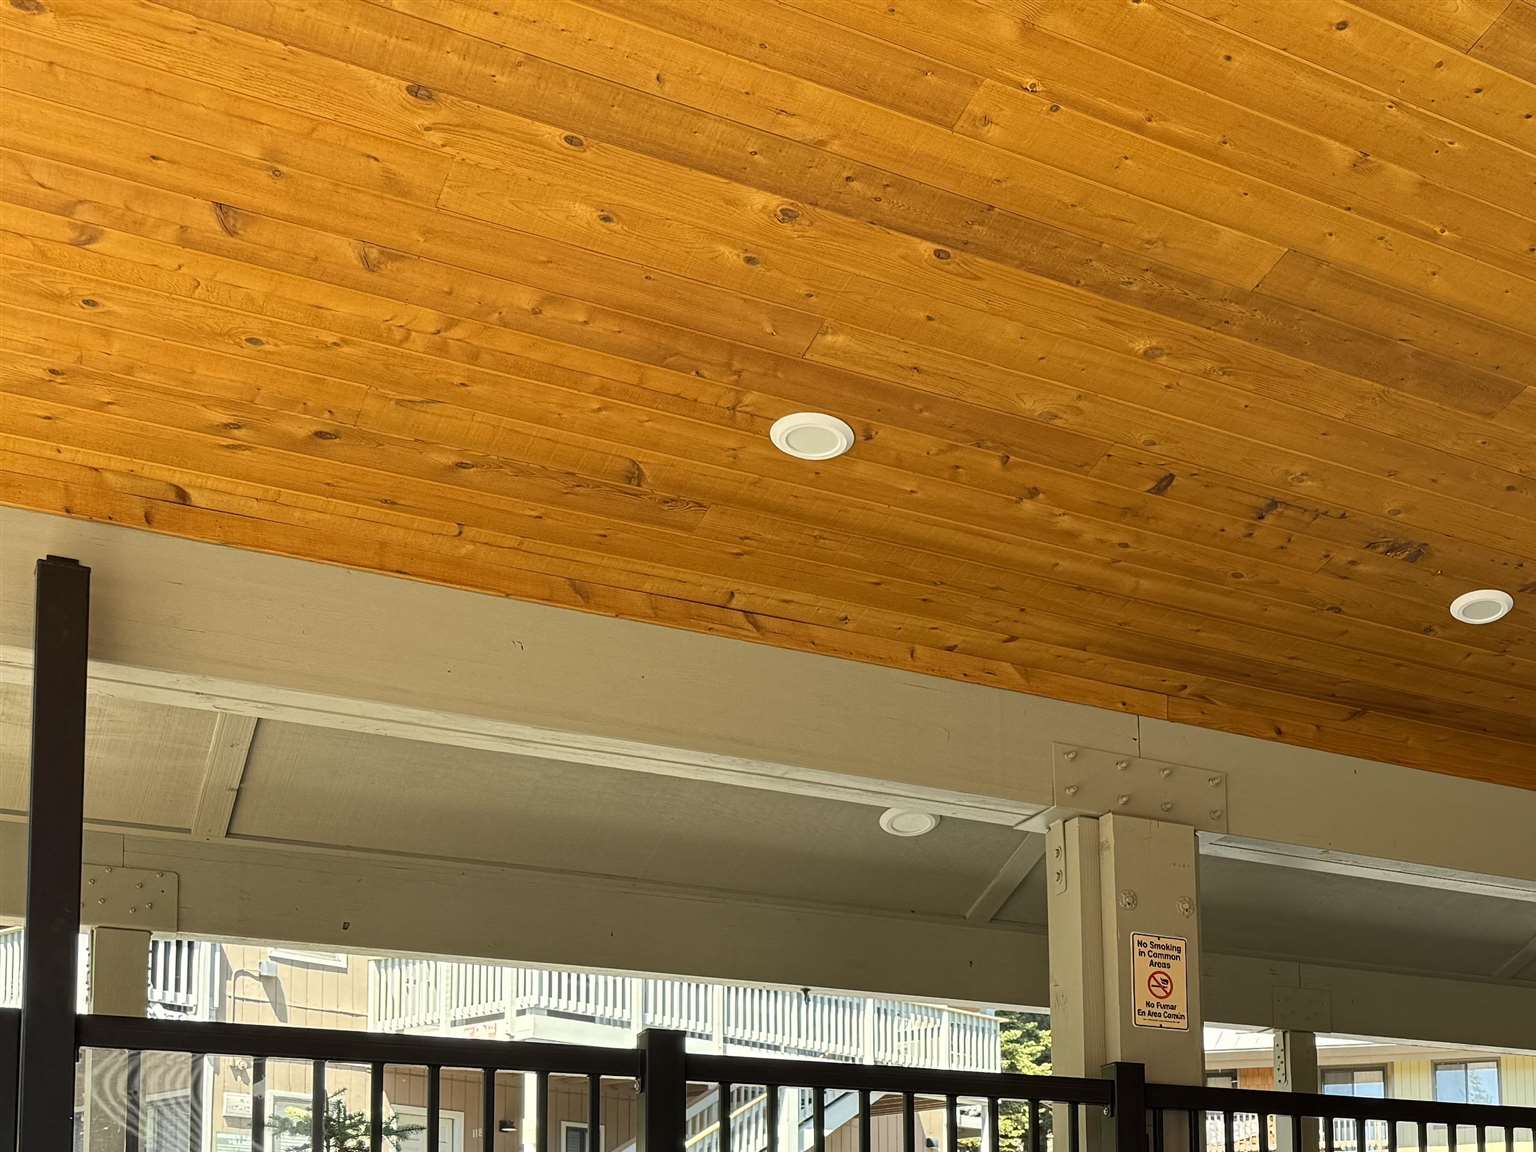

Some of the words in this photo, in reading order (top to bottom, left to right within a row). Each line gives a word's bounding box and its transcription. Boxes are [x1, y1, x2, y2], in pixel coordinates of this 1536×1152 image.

[1137, 940, 1147, 948] No
[1150, 942, 1181, 954] Smoking
[1139, 949, 1145, 957] in
[1148, 950, 1180, 960] Common
[1149, 960, 1170, 969] Areas
[1157, 1002, 1176, 1010] Fumar
